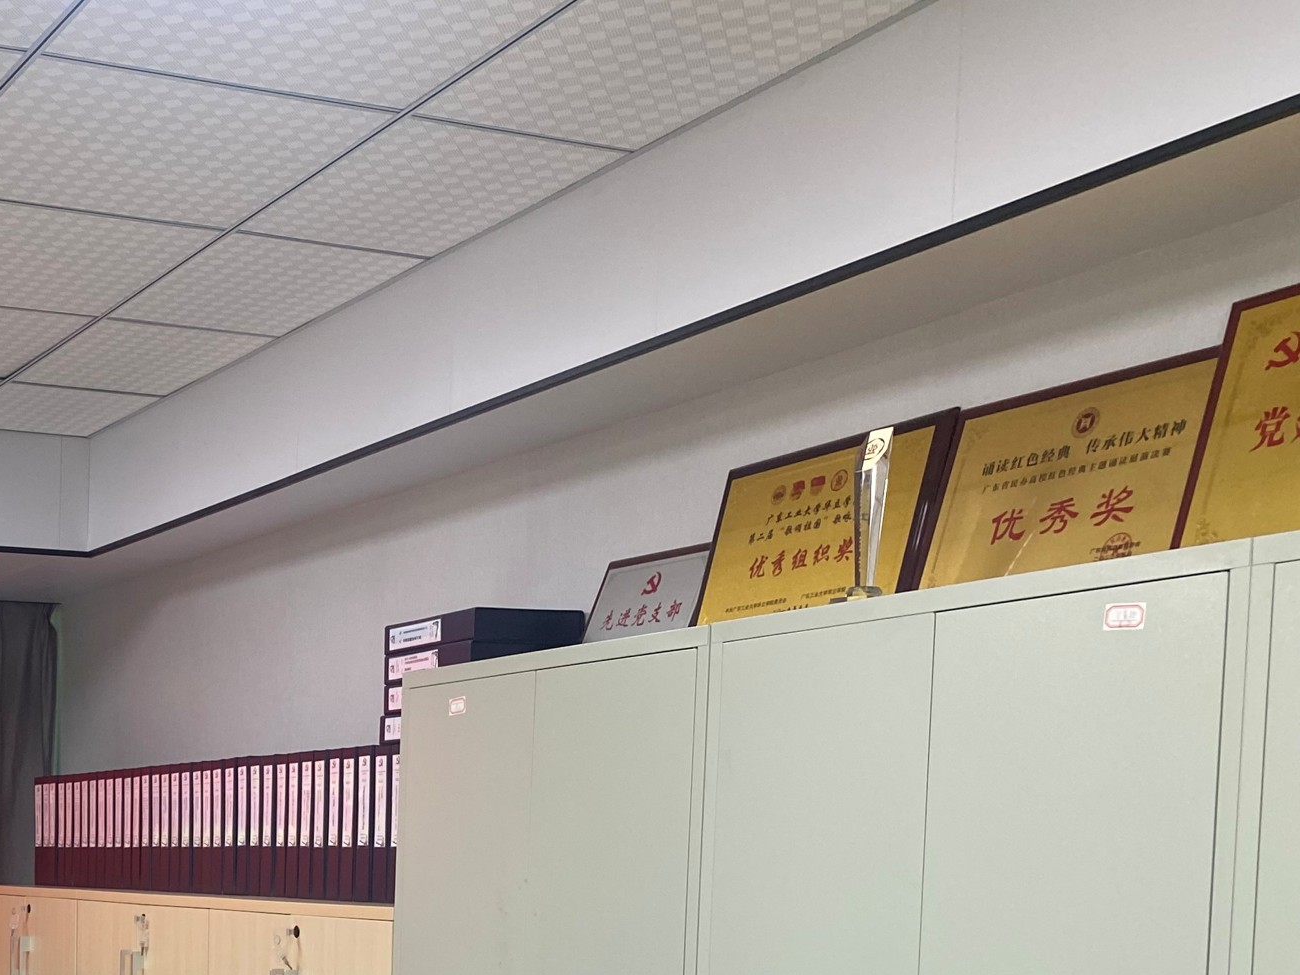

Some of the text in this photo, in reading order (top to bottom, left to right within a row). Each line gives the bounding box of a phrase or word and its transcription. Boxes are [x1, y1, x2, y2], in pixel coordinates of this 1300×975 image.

[981, 418, 1187, 478] 诵读红色经典 传承伟大精神
[1248, 405, 1300, 453] 党
[766, 495, 854, 526] 广东工业大学华立学
[990, 485, 1134, 546] 优秀奖
[749, 536, 853, 580] 优秀组织奖
[600, 600, 682, 631] 先进党支部
